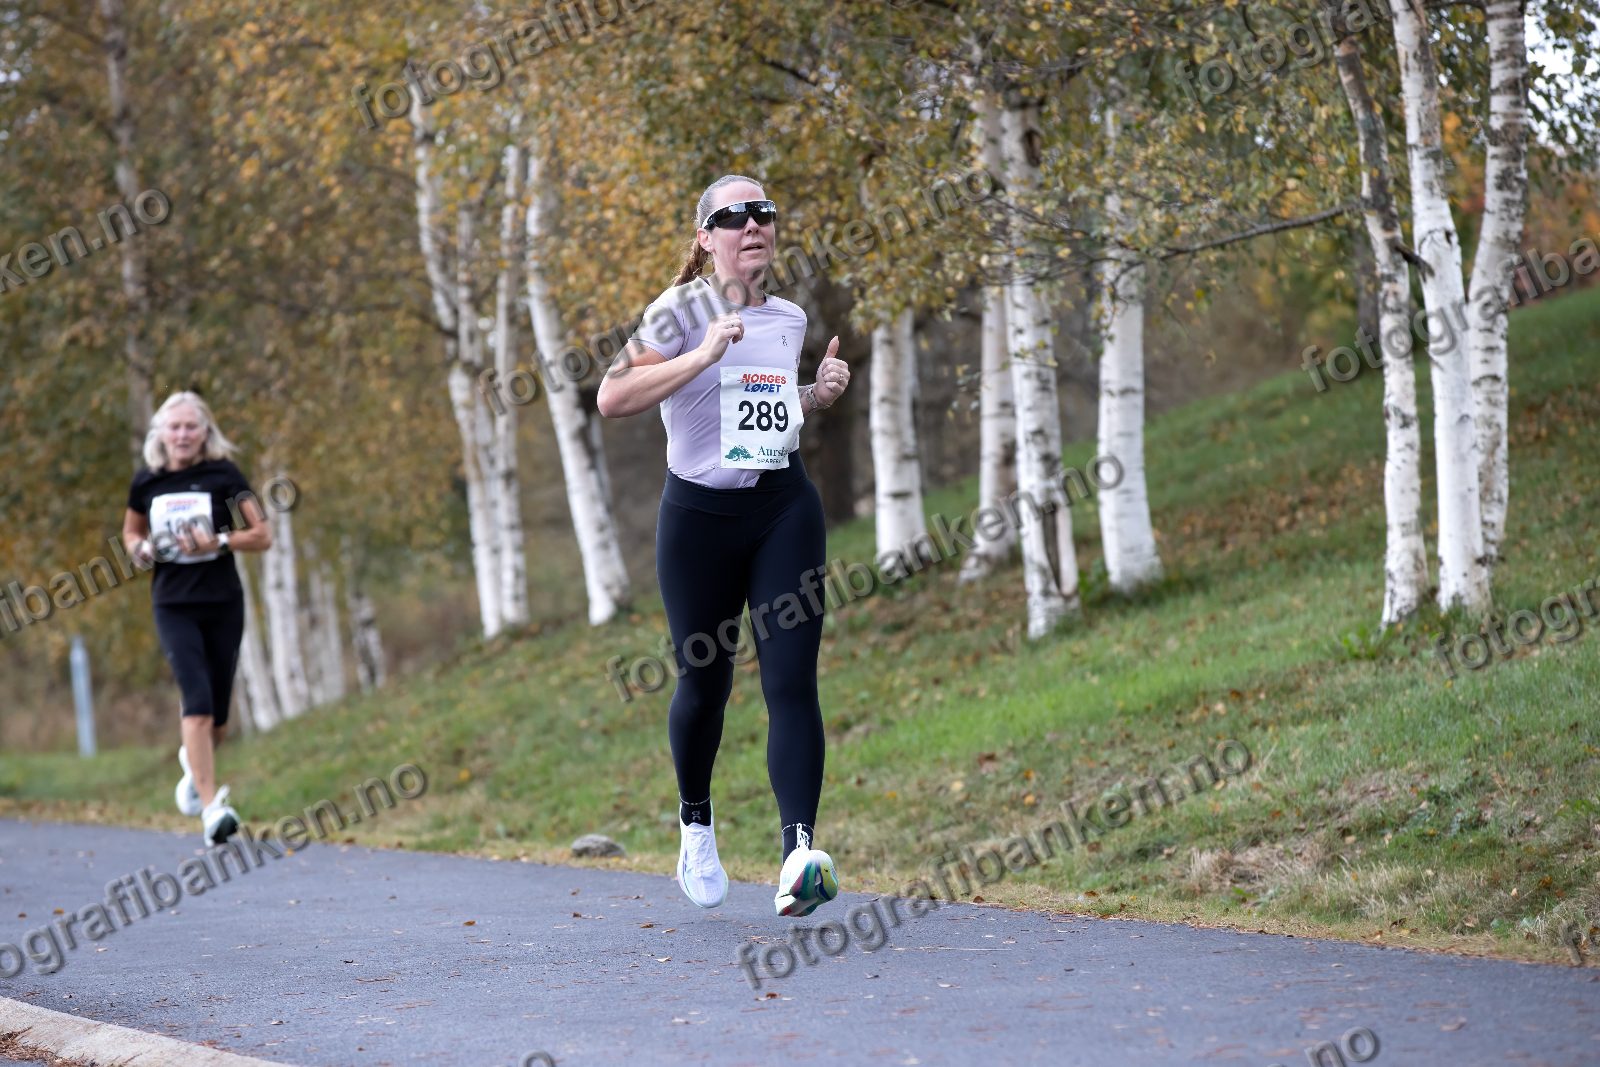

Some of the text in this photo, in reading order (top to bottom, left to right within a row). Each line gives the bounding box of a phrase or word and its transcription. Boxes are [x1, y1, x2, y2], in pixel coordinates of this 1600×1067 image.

[740, 373, 787, 384] NORGES
[743, 383, 781, 393] LØPET
[738, 400, 789, 432] 289
